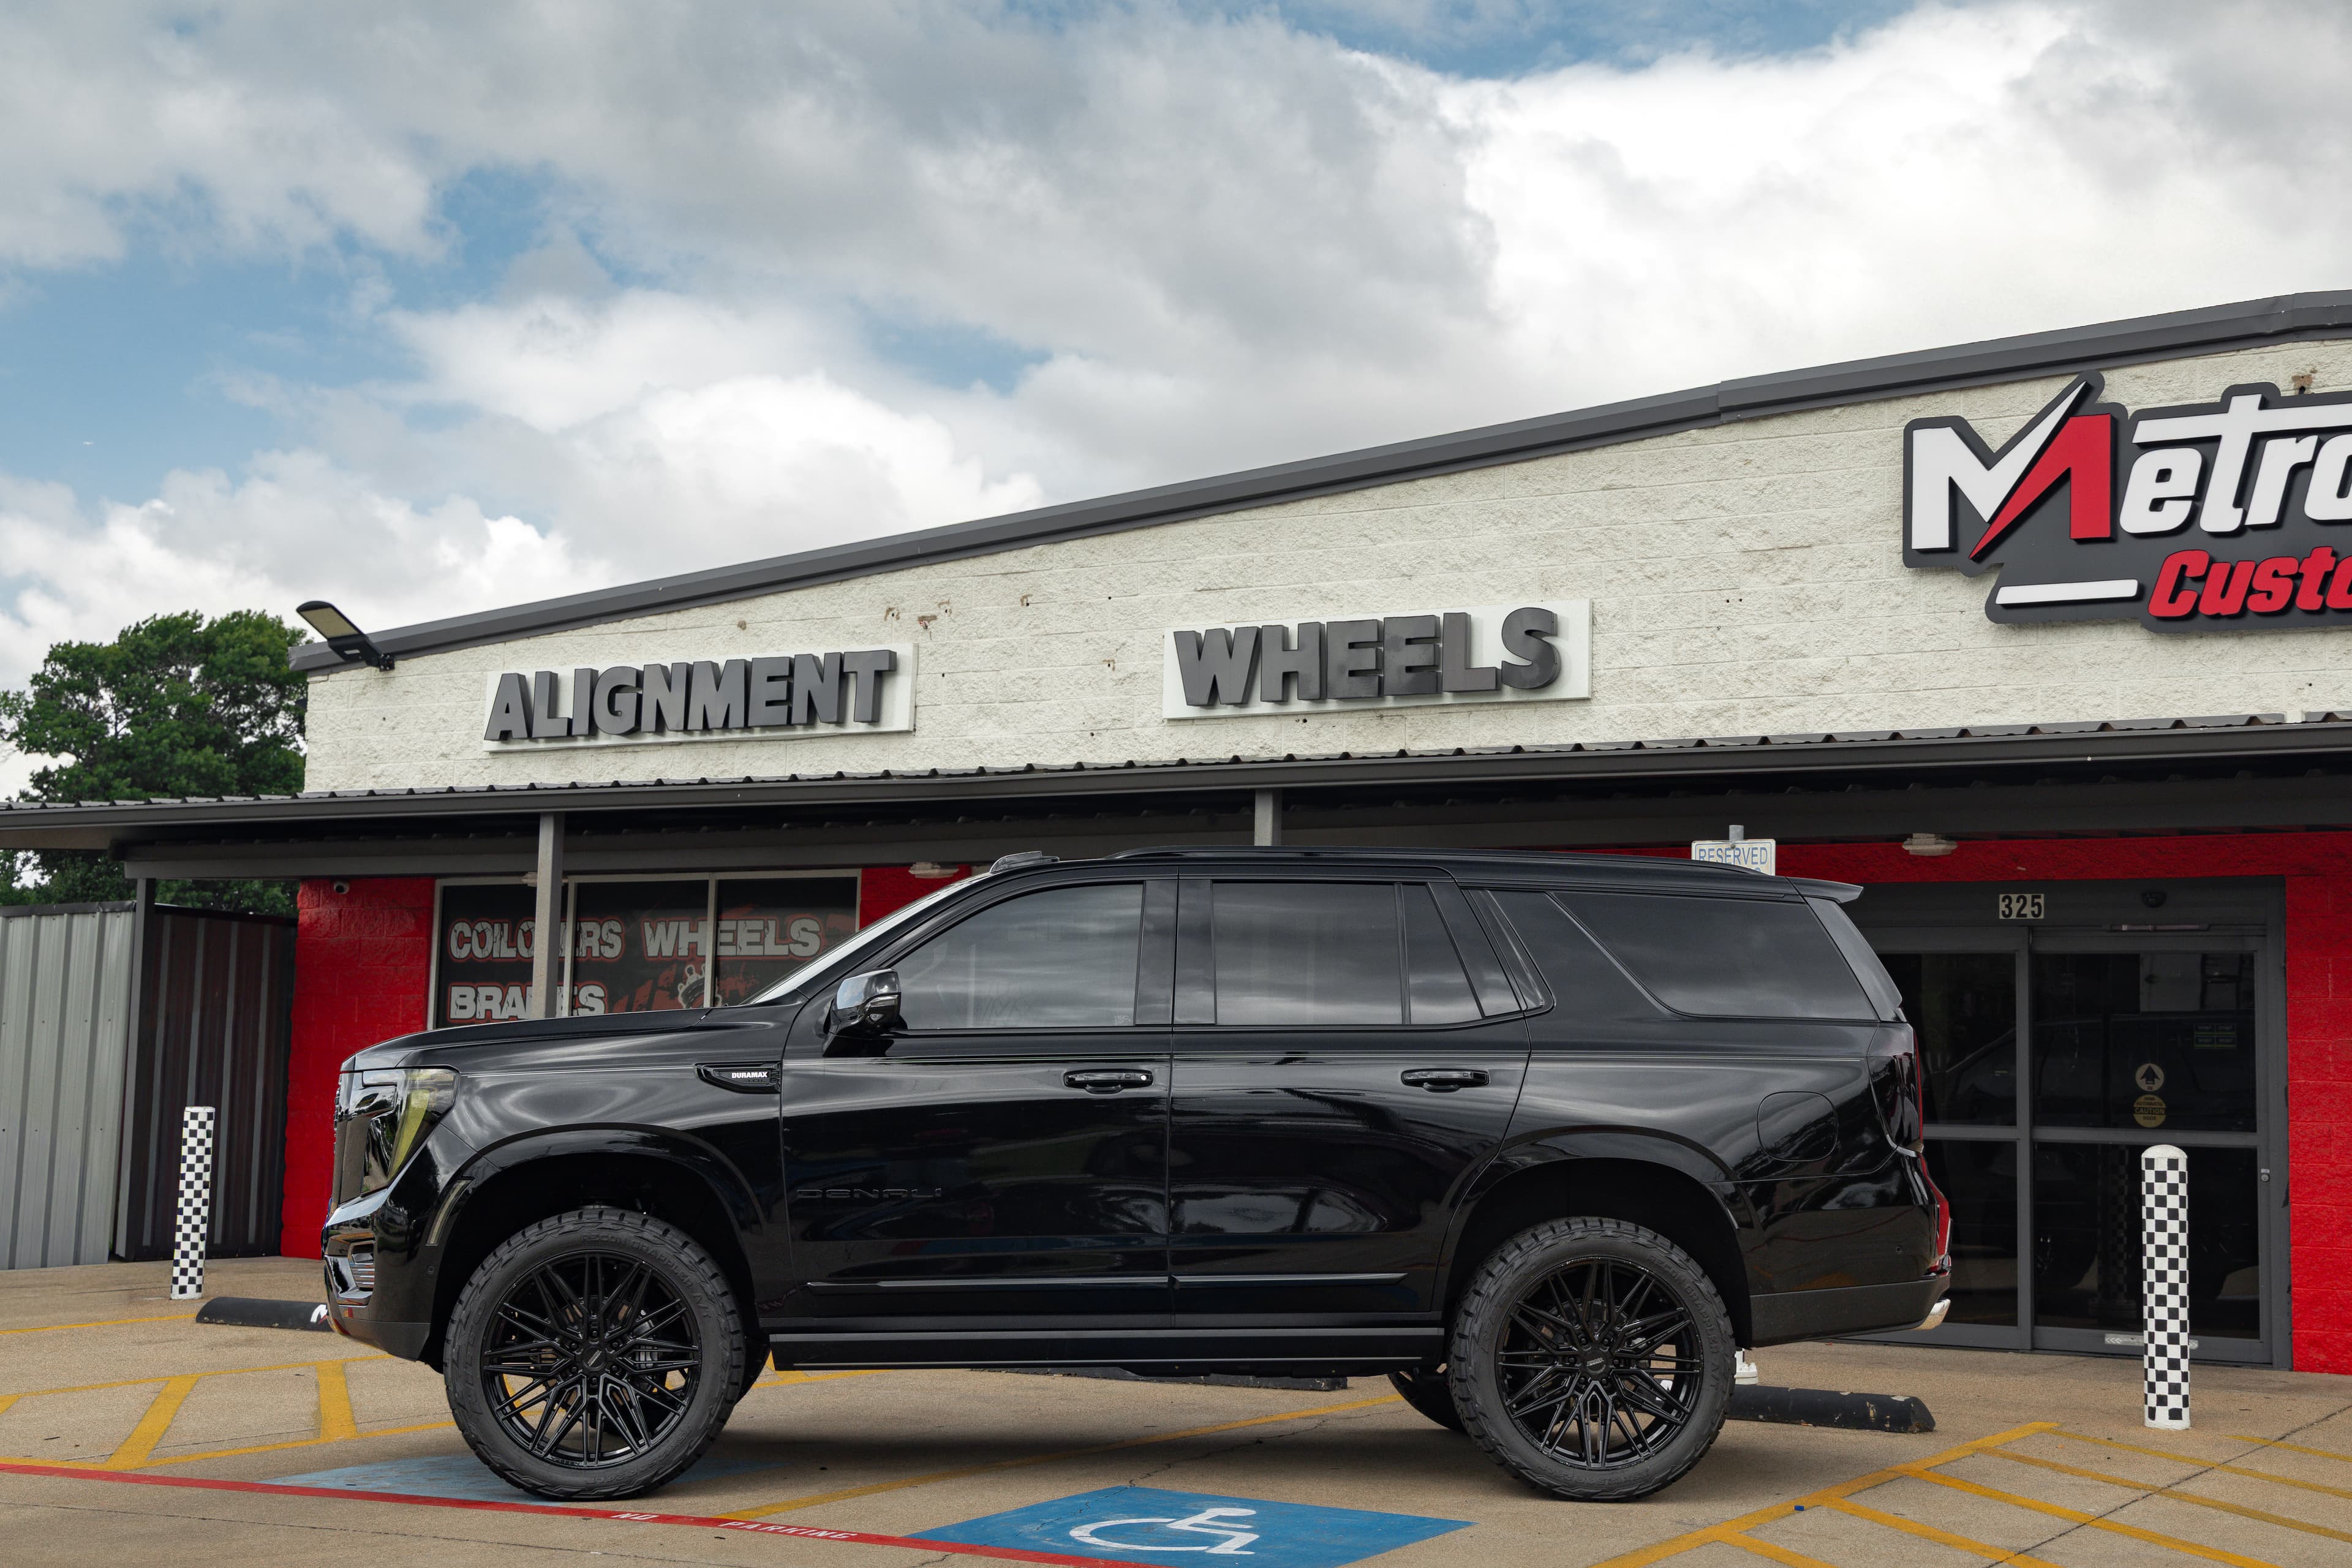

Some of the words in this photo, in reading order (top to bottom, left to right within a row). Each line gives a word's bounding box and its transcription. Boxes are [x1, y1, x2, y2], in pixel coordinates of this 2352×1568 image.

[1173, 607, 1561, 707] WHEELS
[484, 649, 897, 741] ALIGNMENT
[1699, 847, 1768, 865] RESERVED
[2001, 895, 2042, 918] 325
[644, 919, 821, 957] WHEELS
[796, 1188, 941, 1199] DENALI
[582, 1234, 627, 1246] RECON
[631, 1238, 693, 1289] GRAPPLER
[718, 1521, 858, 1539] PARKING
